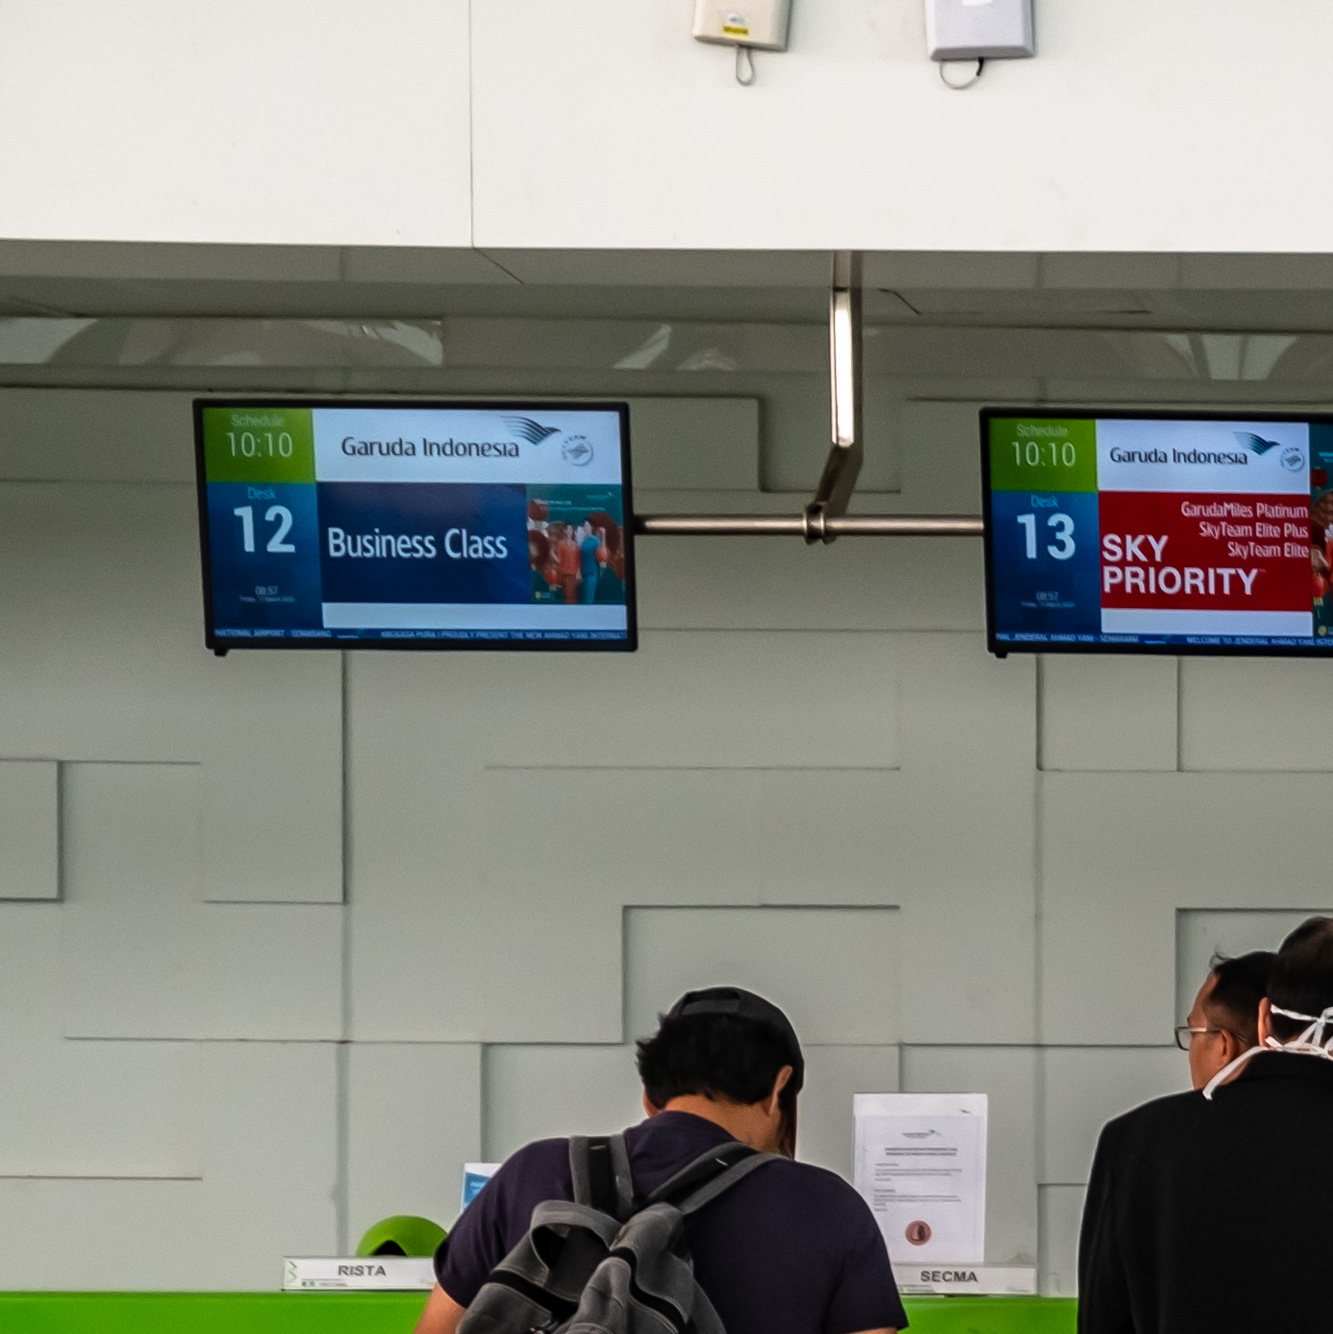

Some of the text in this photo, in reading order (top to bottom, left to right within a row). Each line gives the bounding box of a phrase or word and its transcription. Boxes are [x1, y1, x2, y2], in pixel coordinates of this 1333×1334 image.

[231, 414, 284, 427] Schedule
[1016, 424, 1068, 438] Schedule
[227, 432, 293, 458] 10:10
[341, 436, 520, 458] Garuda Indonesia
[1012, 441, 1076, 468] 10:10
[1110, 447, 1248, 466] Garuda Indonesia
[247, 487, 276, 500] Desk
[1031, 495, 1058, 508] Desk
[1181, 501, 1309, 519] GarudaMiles Platinum
[233, 505, 296, 554] 12
[1017, 513, 1076, 560] 13
[1199, 521, 1309, 539] SkyTeam Elite Plus
[328, 526, 509, 559] Business Class
[1103, 535, 1169, 562] SKY
[1228, 541, 1310, 559] SkyTeam Elite
[1103, 568, 1259, 596] PRIORITY
[338, 1265, 386, 1276] RISTA
[921, 1271, 978, 1283] SECMA
